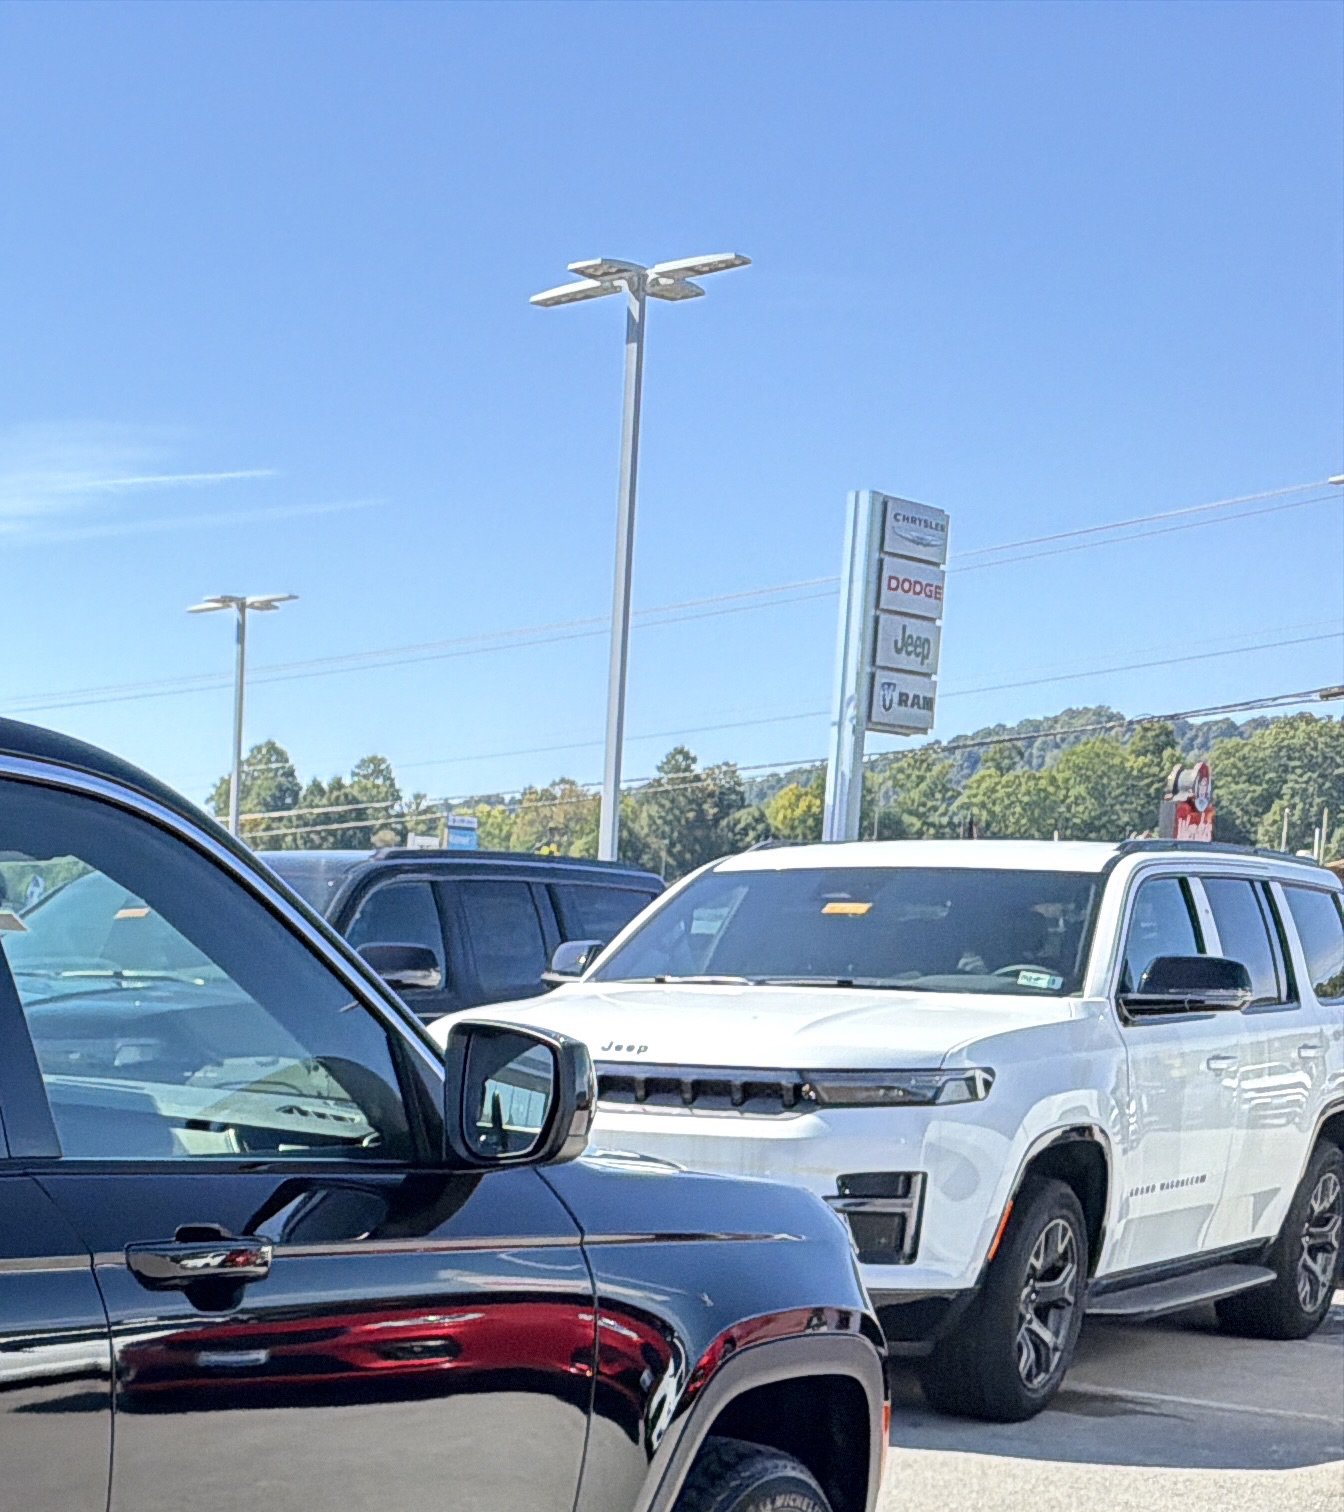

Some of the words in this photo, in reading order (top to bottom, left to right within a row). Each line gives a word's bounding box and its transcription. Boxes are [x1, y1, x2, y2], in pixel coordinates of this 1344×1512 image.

[893, 512, 945, 532] CHRYSLER
[887, 575, 943, 600] DODGE
[893, 624, 931, 666] Jeep
[898, 691, 934, 712] RAM
[601, 1041, 648, 1054] Jeep
